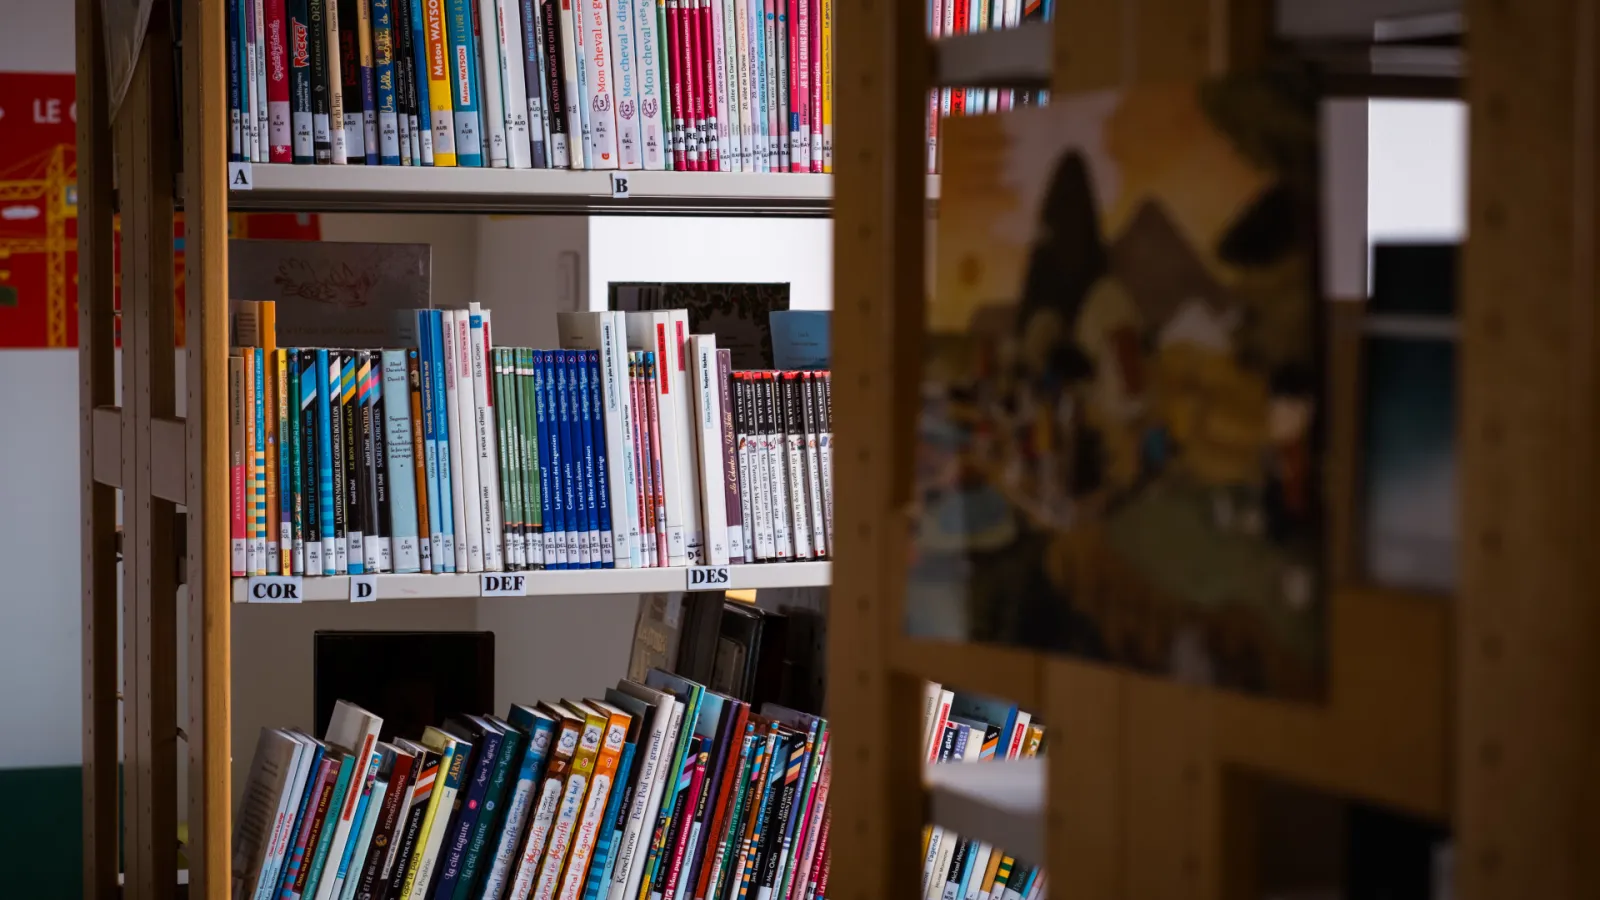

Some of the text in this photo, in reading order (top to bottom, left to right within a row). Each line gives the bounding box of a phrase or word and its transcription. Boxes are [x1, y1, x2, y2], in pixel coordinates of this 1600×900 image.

[378, 13, 388, 24] de
[292, 16, 310, 68] ROCKET
[592, 12, 606, 92] Mon cheval est
[618, 34, 629, 72] cheval
[640, 8, 654, 95] Mon cheval très
[432, 44, 443, 75] Matou
[459, 48, 467, 80] WATSON
[800, 61, 807, 69] TE
[380, 70, 392, 90] belle
[622, 75, 631, 97] Mon
[800, 71, 808, 79] NE
[800, 80, 807, 88] JE
[333, 93, 343, 108] loup
[552, 78, 560, 102] CONTES
[33, 98, 61, 124] LE
[233, 169, 249, 184] A
[615, 179, 627, 192] B
[723, 411, 733, 445] Roi-Soleil
[727, 456, 736, 481] Colombes
[486, 575, 526, 591] DEF
[691, 568, 728, 583] DES
[253, 582, 298, 599] COR
[358, 583, 372, 598] D
[943, 730, 954, 749] girls
[447, 752, 464, 780] ARNO
[630, 729, 662, 819] Petit Poil veut grandir
[384, 774, 405, 829] STEPHEN HAWKING
[744, 787, 754, 811] LULLABY
[780, 786, 789, 808] CLIENTS
[758, 786, 777, 847] L'APPEL DE LA FORÊT
[778, 822, 786, 834] BON
[786, 787, 794, 804] JAUNE
[392, 808, 421, 888] UN CHIEN POUR TOUJOURS
[470, 822, 487, 852] lagune
[665, 828, 674, 849] FUTURE
[927, 834, 941, 862] L'agenda
[444, 821, 470, 879] La cité lagune
[466, 853, 476, 868] cité
[615, 831, 636, 883] Korschunow
[667, 812, 692, 888] Mon papa est astronaute
[753, 851, 761, 870] London
[367, 864, 376, 876] BIG
[414, 858, 431, 896] La Prophétie
[765, 851, 778, 882] Mac Orlan
[948, 861, 961, 882] Michael
[362, 882, 370, 892] ET
[365, 875, 373, 883] LE
